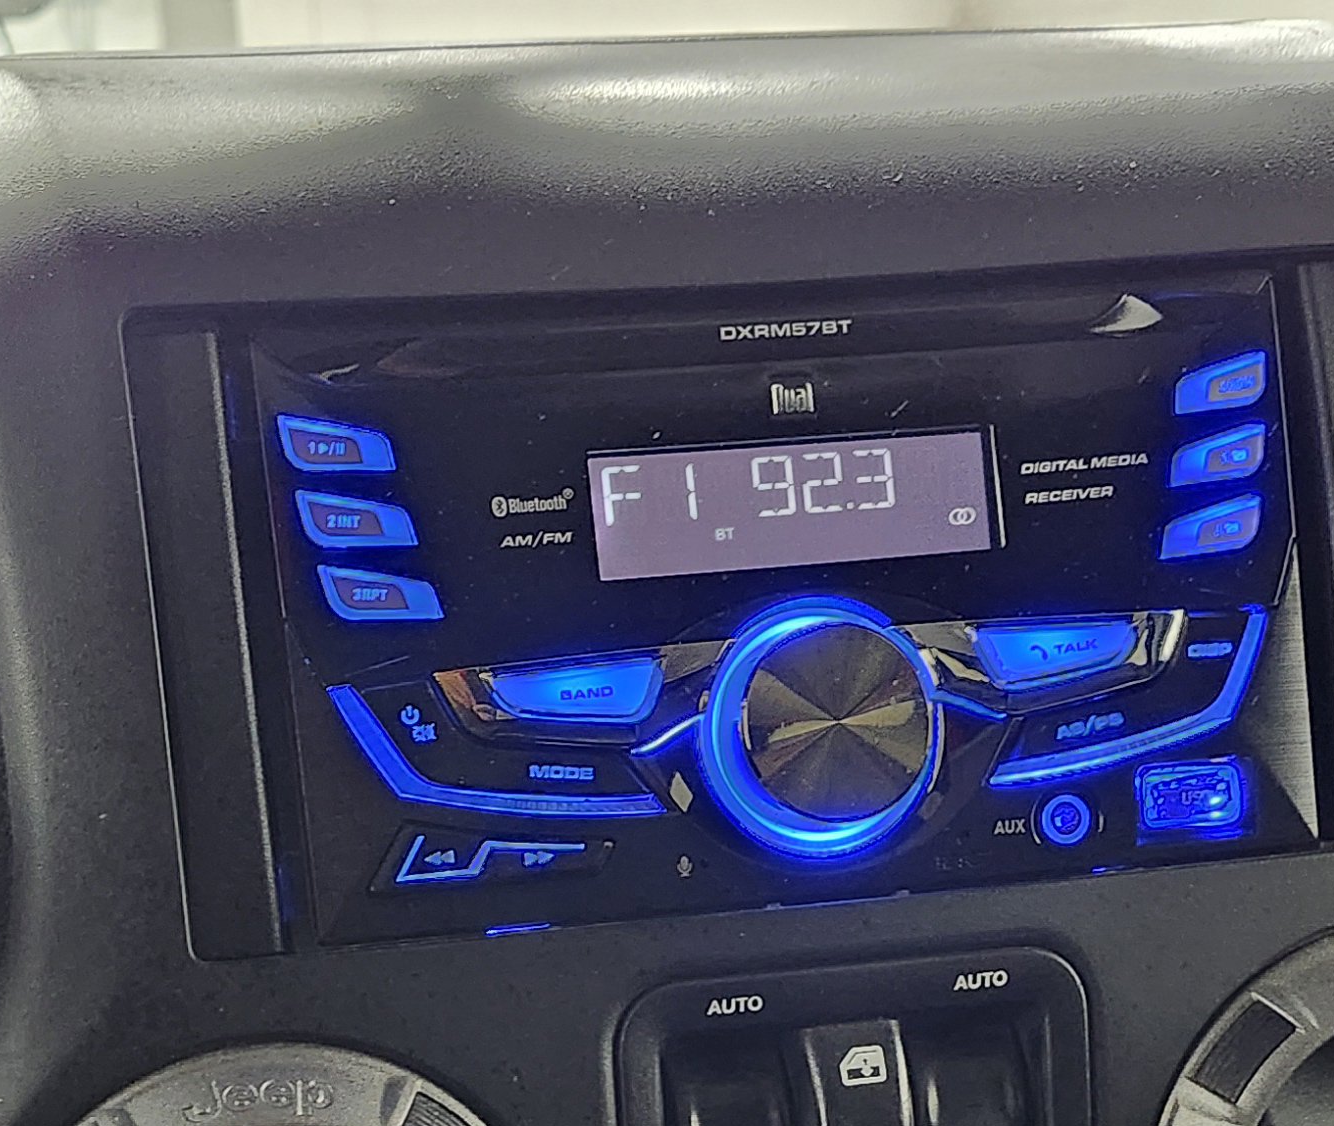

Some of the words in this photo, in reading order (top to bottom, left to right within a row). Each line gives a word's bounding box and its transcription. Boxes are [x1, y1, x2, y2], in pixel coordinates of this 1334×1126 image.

[720, 319, 852, 341] DXRM57BT
[770, 382, 815, 415] Dual
[1020, 456, 1089, 475] DIGITAL
[1090, 452, 1149, 470] MEDIA
[750, 447, 897, 517] 92.3
[1025, 485, 1114, 504] RECEIVER
[500, 531, 573, 549] AM/FM
[714, 527, 735, 542] BT
[1054, 638, 1098, 654] TALK
[560, 685, 614, 701] BAND
[529, 764, 595, 781] MODE
[993, 819, 1026, 835] AUX
[953, 969, 1009, 992] AUTO
[706, 995, 764, 1017] AUTO
[181, 1075, 336, 1125] Jeep
